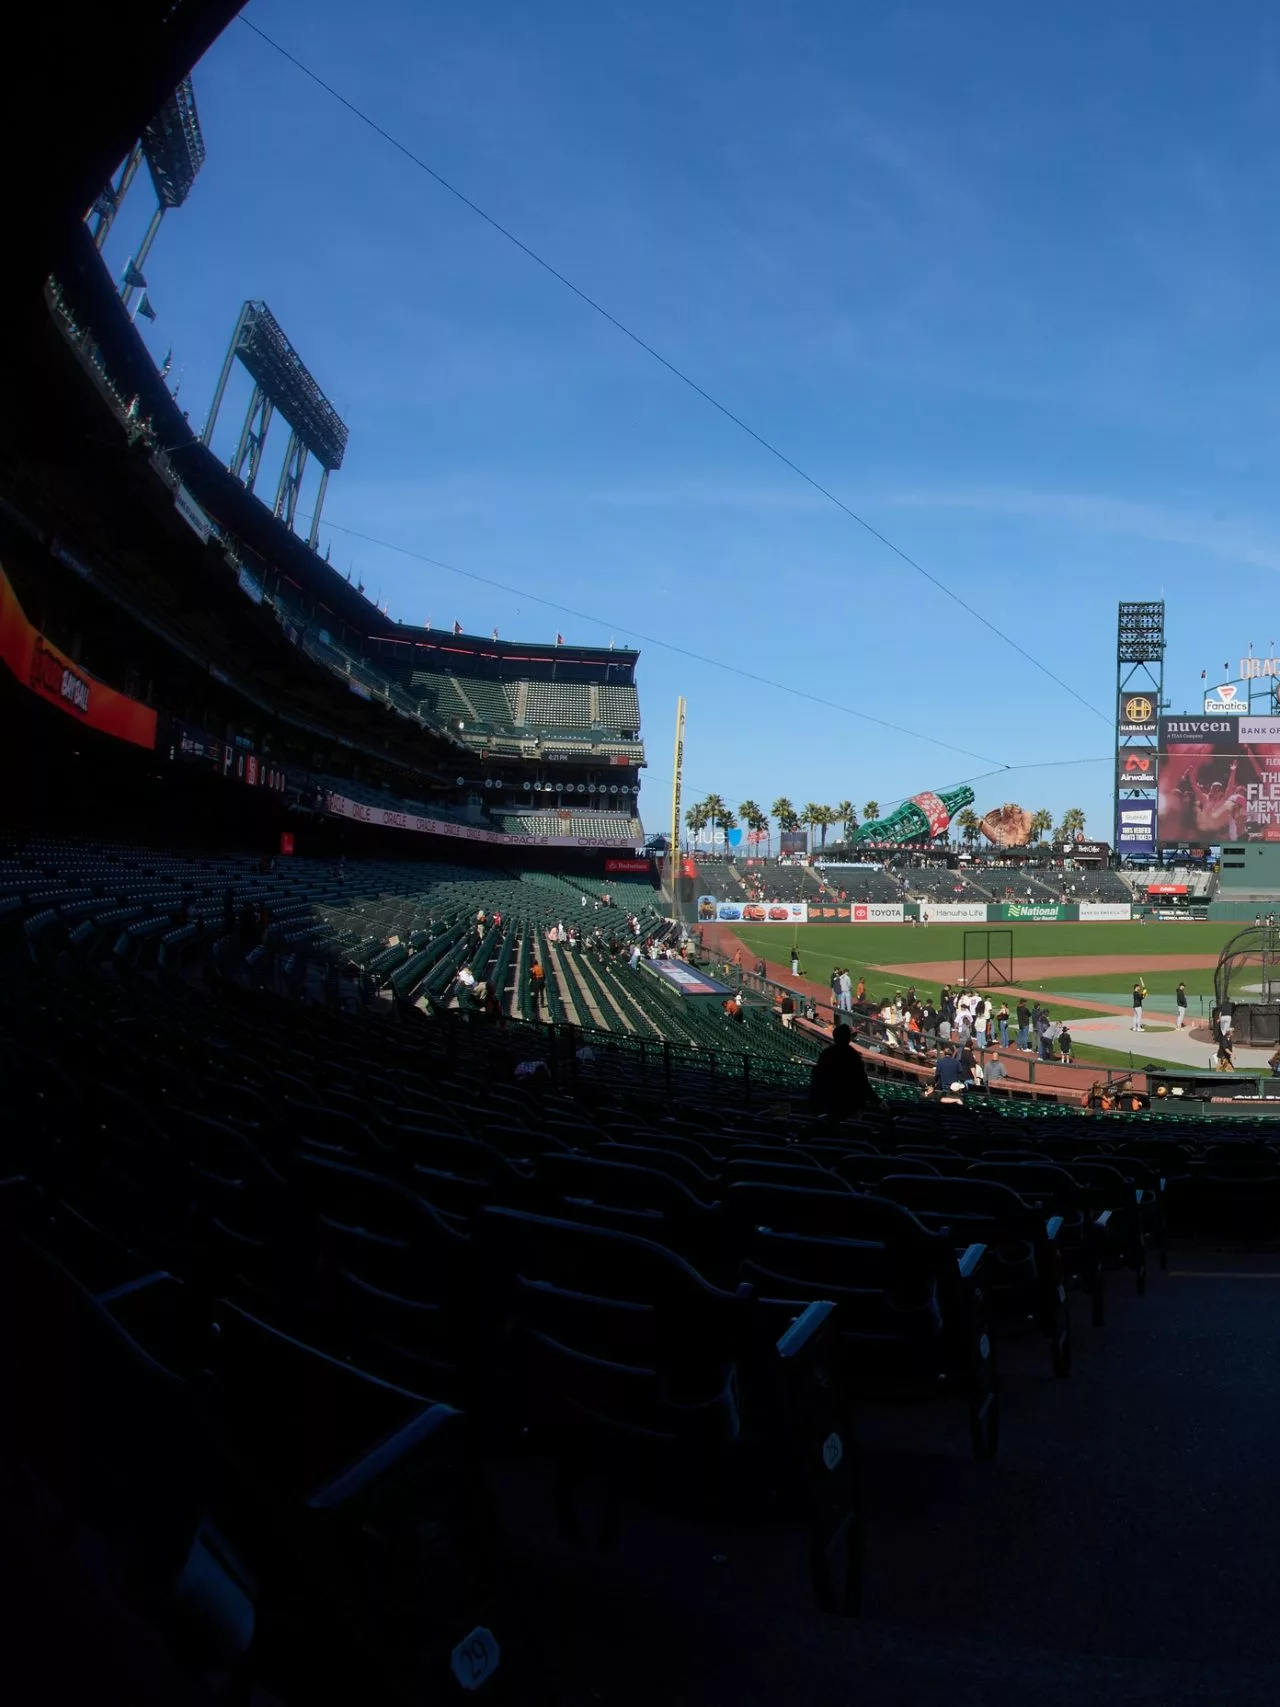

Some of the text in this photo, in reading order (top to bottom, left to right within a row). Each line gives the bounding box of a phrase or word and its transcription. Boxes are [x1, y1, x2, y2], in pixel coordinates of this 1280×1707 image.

[1207, 700, 1247, 710] Fanatics
[1167, 721, 1231, 732] nuveen
[1241, 727, 1267, 735] BANK
[1182, 733, 1204, 741] Company
[1265, 758, 1280, 766] FLEX
[1121, 773, 1155, 781] Airwallex
[1258, 813, 1271, 824] IN
[503, 835, 629, 847] ORACLE ORACLE
[871, 909, 901, 917] TOYOTA
[936, 908, 984, 918] Hanwha Life
[1020, 906, 1059, 917] National
